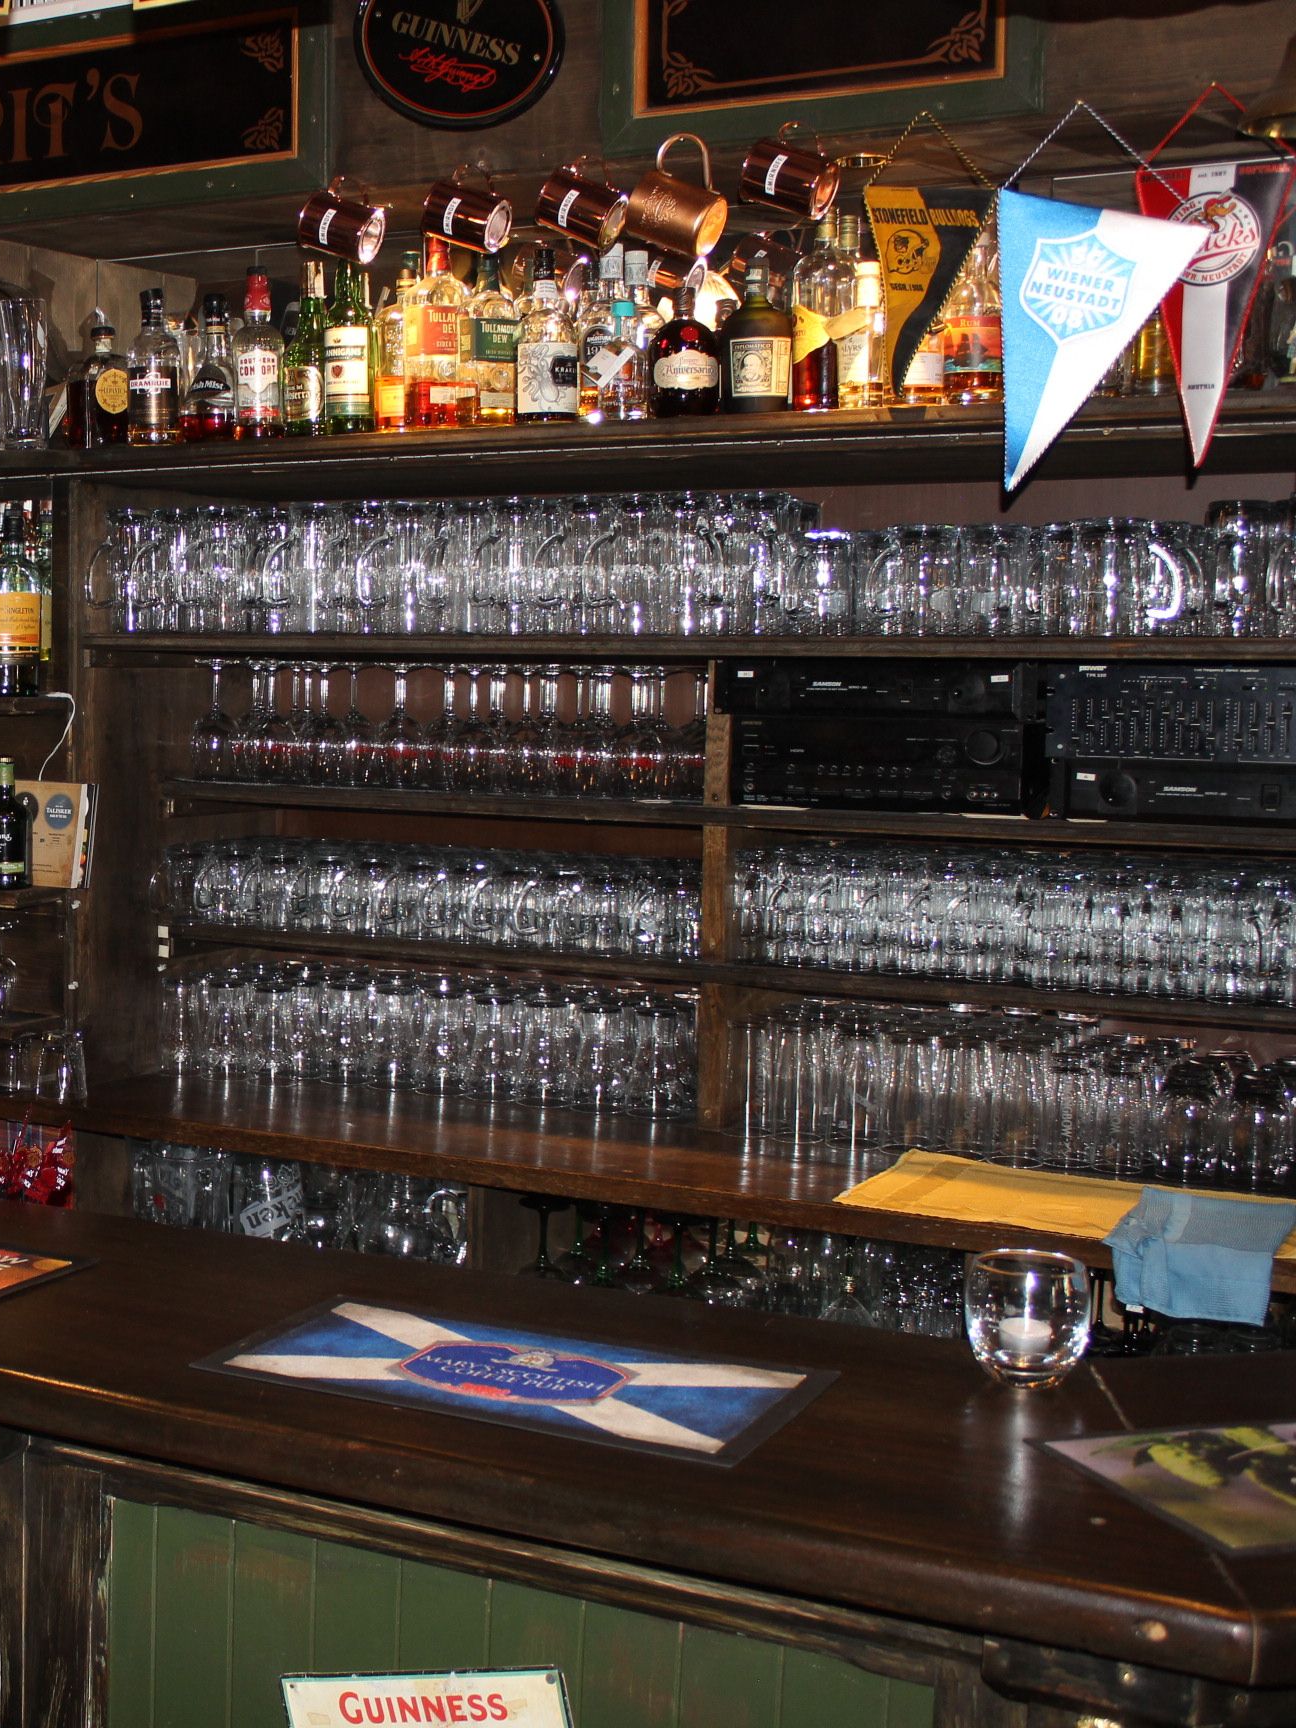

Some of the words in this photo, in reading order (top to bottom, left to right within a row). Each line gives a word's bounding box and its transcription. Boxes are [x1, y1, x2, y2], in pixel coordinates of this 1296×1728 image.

[392, 11, 522, 66] GUINNESS
[767, 156, 786, 193] SMIRNOFF
[445, 199, 460, 233] SMIRNOFF
[558, 191, 579, 226] SMIRNOFF
[873, 208, 928, 225] STONEFIELD
[929, 208, 979, 227] BULLDOGS
[320, 210, 335, 243] SMIRNOFF
[1047, 266, 1115, 292] WIENER
[1201, 252, 1248, 282] NEUSTADT
[1029, 281, 1121, 311] NEUSTADT
[492, 334, 508, 344] DEW
[131, 380, 169, 388] DRAMBUIE
[206, 380, 224, 391] Mist
[239, 365, 276, 376] COMORT
[4, 606, 34, 615] SINGLETON
[420, 1354, 492, 1376] MARY'S
[500, 1368, 606, 1392] SCOTTISH
[441, 1365, 519, 1384] COFFEE
[522, 1377, 568, 1392] PUB
[339, 1691, 508, 1724] GUINNESS
